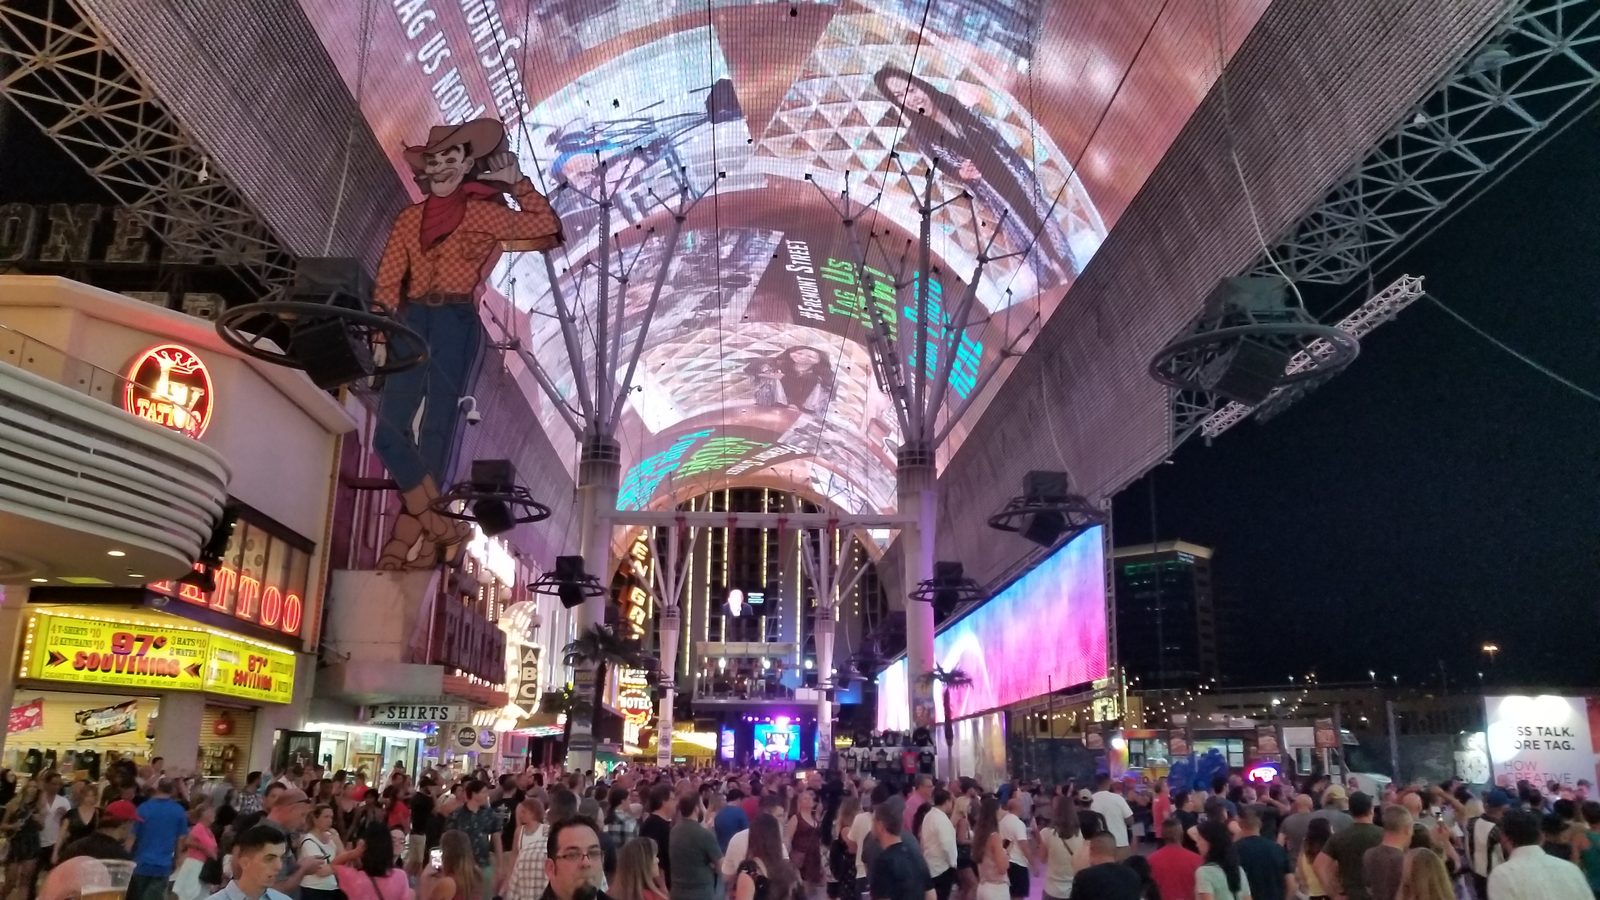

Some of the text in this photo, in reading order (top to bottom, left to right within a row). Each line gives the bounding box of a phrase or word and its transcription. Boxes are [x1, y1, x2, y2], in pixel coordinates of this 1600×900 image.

[417, 30, 451, 75] US
[481, 36, 530, 125] STREET
[786, 239, 814, 274] STREET
[820, 258, 855, 285] US
[72, 650, 182, 677] SOUVENIRS
[520, 648, 538, 698] ABC
[368, 705, 449, 720] T-SHIRTS
[1536, 726, 1575, 737] TALK.
[1544, 740, 1575, 751] TAG.
[1504, 760, 1537, 771] HOW
